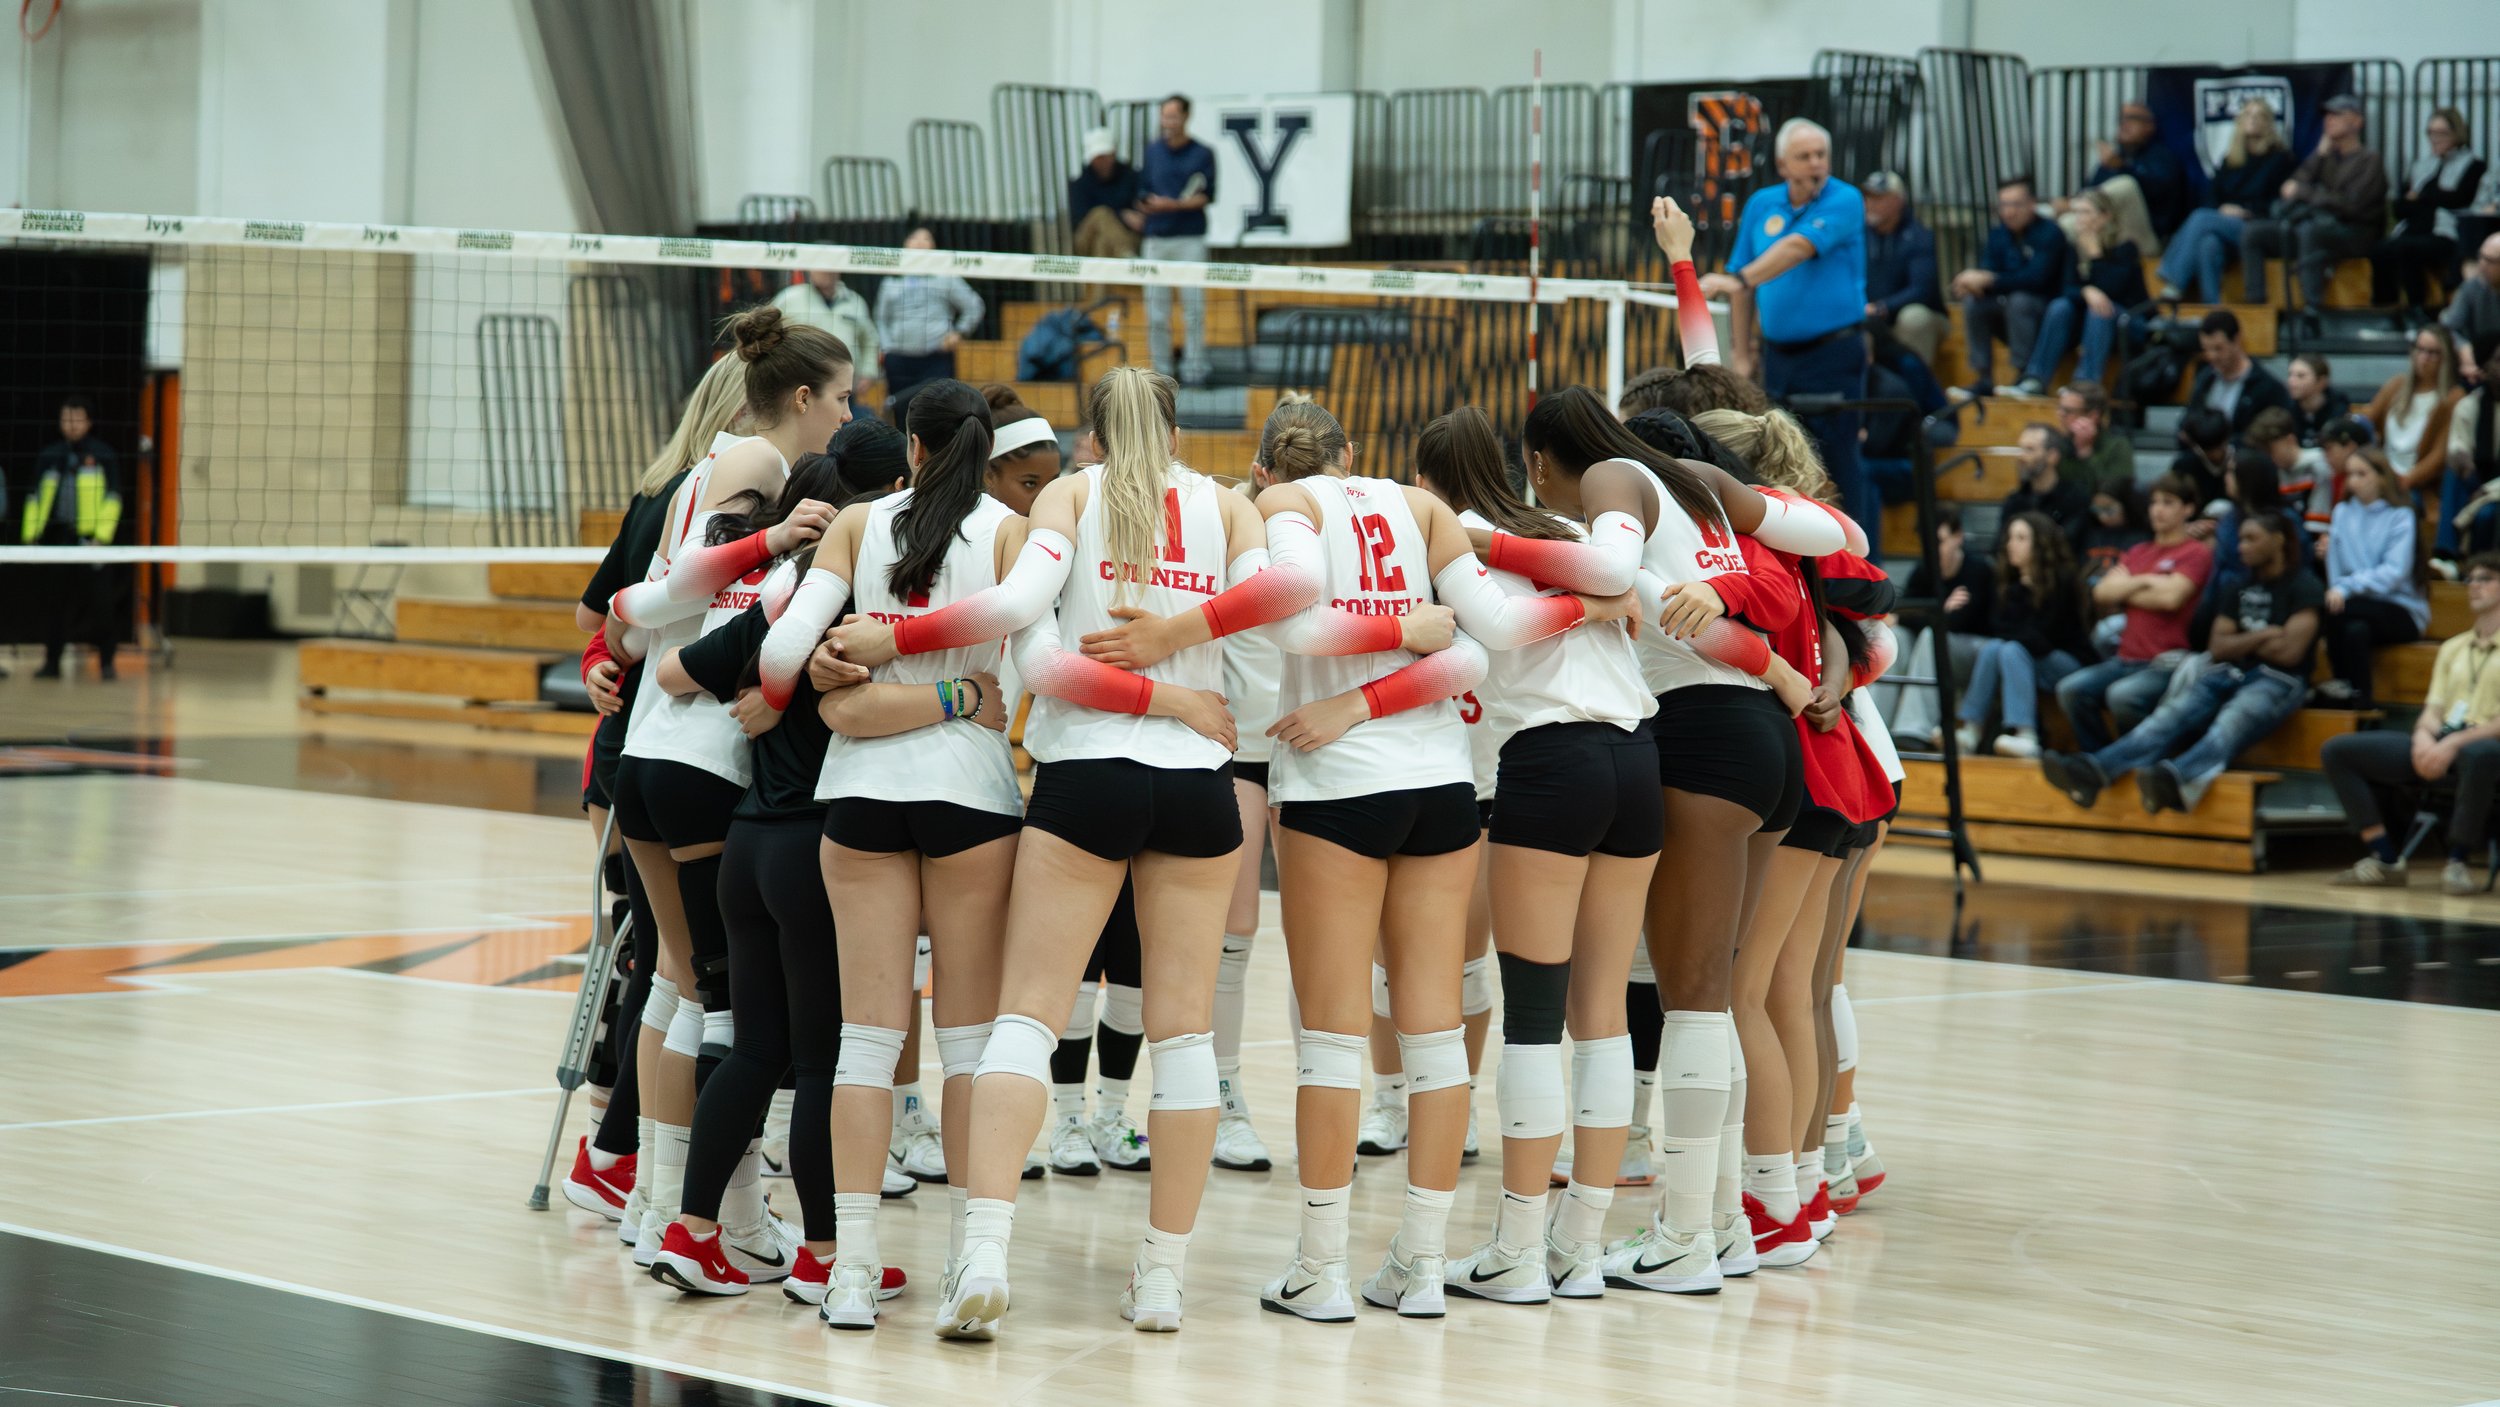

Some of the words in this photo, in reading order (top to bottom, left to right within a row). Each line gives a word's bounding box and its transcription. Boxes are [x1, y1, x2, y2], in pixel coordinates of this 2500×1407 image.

[1221, 111, 1313, 235] Y
[21, 220, 84, 232] EXPERIENCE
[146, 215, 170, 236] Ivy
[1154, 488, 1185, 563] 1
[1351, 513, 1407, 592] 12
[1331, 598, 1423, 616] CORNE
